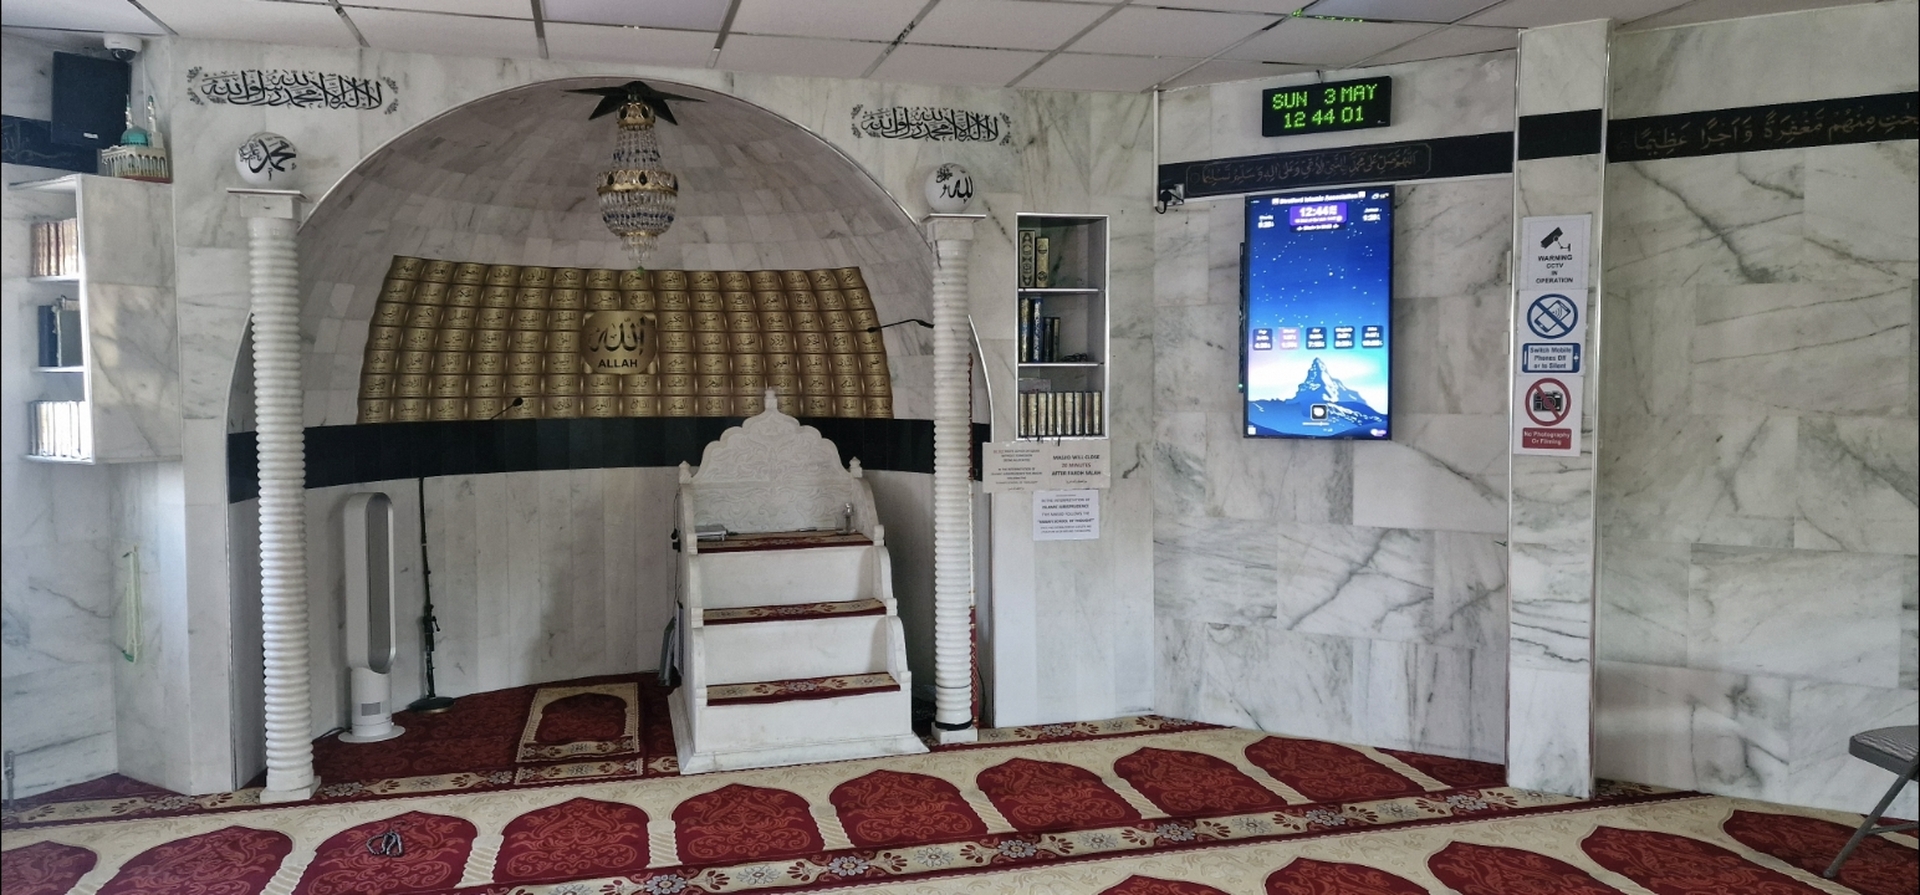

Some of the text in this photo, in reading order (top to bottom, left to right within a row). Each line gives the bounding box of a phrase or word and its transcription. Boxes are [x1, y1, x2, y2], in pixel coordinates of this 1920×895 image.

[1272, 83, 1378, 110] SUN 3 MAY
[1284, 105, 1364, 129] 12 44 01
[1299, 205, 1329, 217] 12:44
[589, 317, 645, 356] الله
[598, 358, 638, 368] ALLAH
[1534, 431, 1570, 439] Photography
